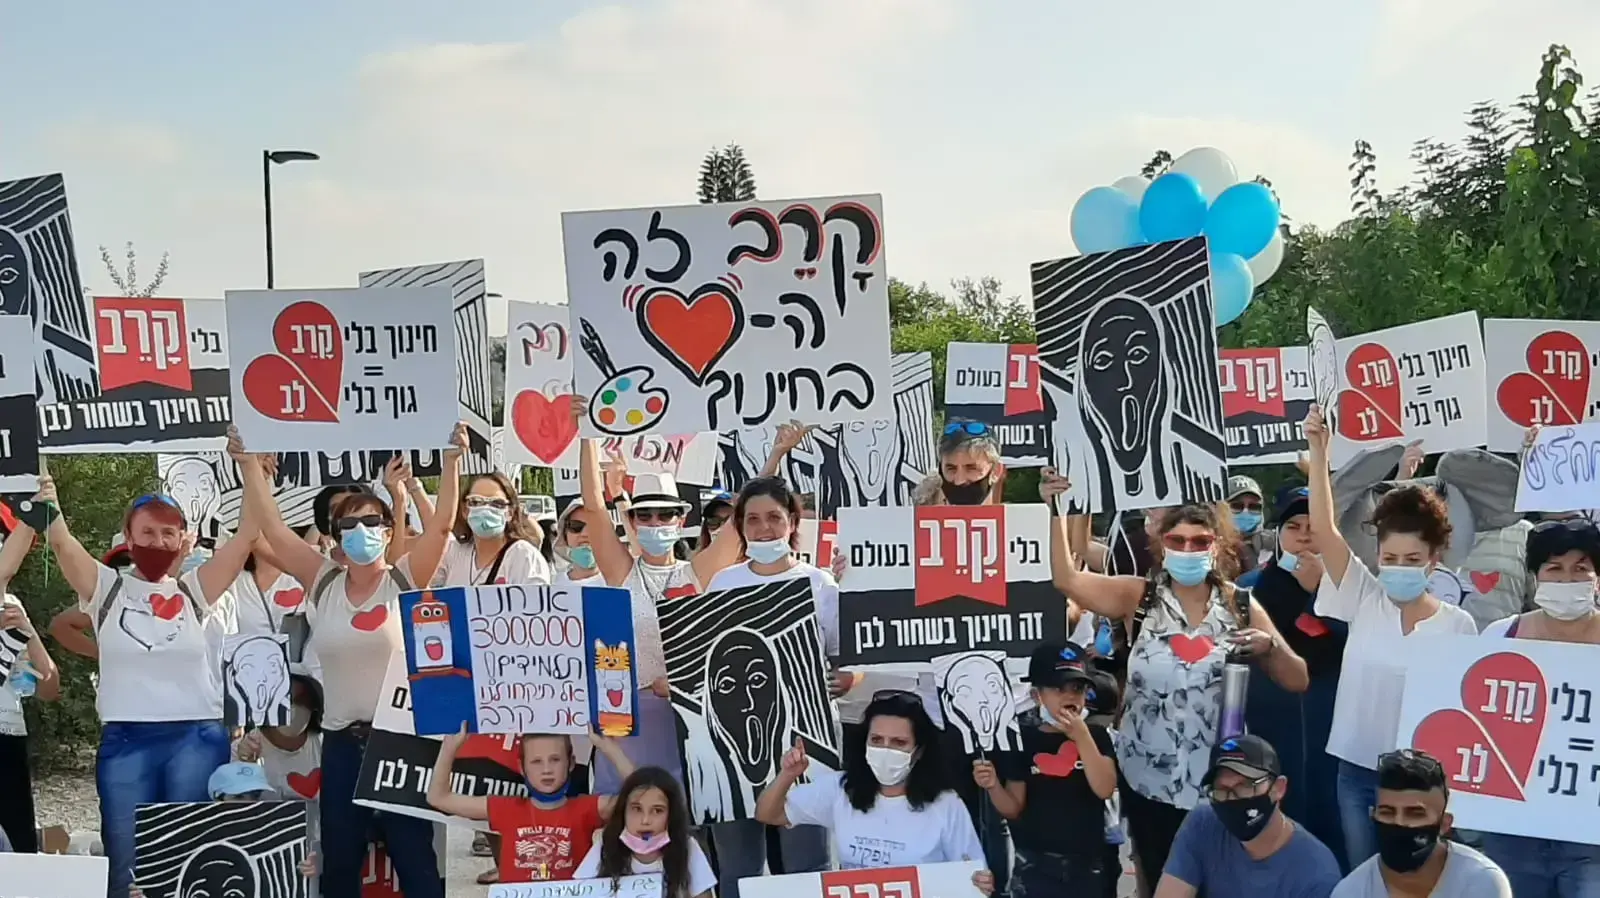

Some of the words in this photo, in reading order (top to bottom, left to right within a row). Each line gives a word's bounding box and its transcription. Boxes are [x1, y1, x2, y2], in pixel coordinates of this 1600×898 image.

[191, 328, 222, 353] בלי
[344, 321, 378, 354] בלי
[384, 324, 438, 360] חינוך
[956, 366, 1002, 388] בעולם
[1398, 352, 1425, 379] בלי
[1427, 344, 1471, 379] חינוך
[1284, 368, 1309, 389] בלי
[205, 396, 231, 423] זה
[344, 381, 378, 414] בלי
[384, 385, 419, 420] גוף
[705, 362, 875, 431] בחינוך
[1434, 396, 1462, 428] גוף
[38, 401, 73, 438] לבן
[76, 401, 147, 430] בשחור
[150, 397, 201, 431] חינוך
[1404, 401, 1432, 427] בלי
[1252, 420, 1292, 449] חינוך
[851, 540, 910, 568] בעולם
[1010, 536, 1041, 564] בלי
[475, 585, 569, 617] אנחנו
[854, 615, 887, 655] לבן
[890, 616, 957, 648] בשחור
[961, 613, 1013, 649] חינוך
[1019, 612, 1044, 641] זה
[560, 680, 585, 703] אל
[1551, 682, 1592, 724] בלי
[479, 704, 534, 733] קרב
[550, 706, 588, 728] את
[373, 758, 408, 791] לבן
[1537, 754, 1579, 796] בלי
[849, 844, 891, 865] מפקיר
